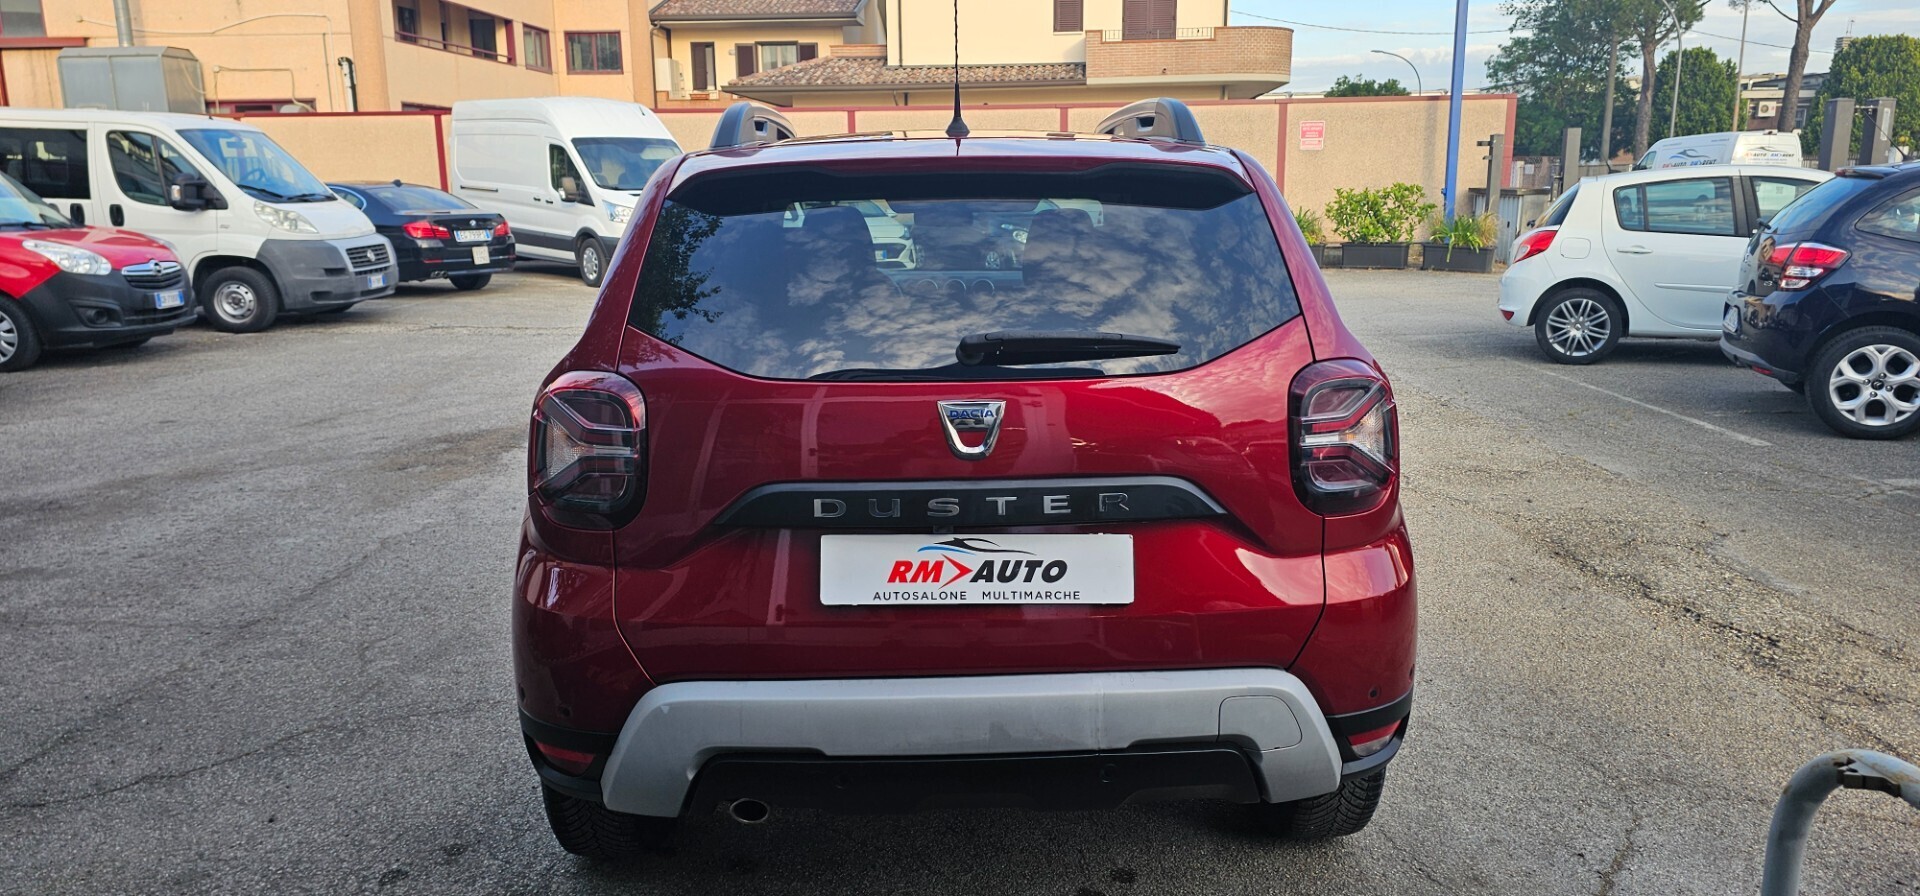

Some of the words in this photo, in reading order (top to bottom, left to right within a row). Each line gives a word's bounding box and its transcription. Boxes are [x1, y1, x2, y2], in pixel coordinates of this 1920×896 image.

[950, 409, 995, 418] DACIA
[813, 492, 1130, 518] DUSTER
[873, 591, 968, 601] AUTOSALONE
[982, 591, 1081, 601] MULTIMARCHE
